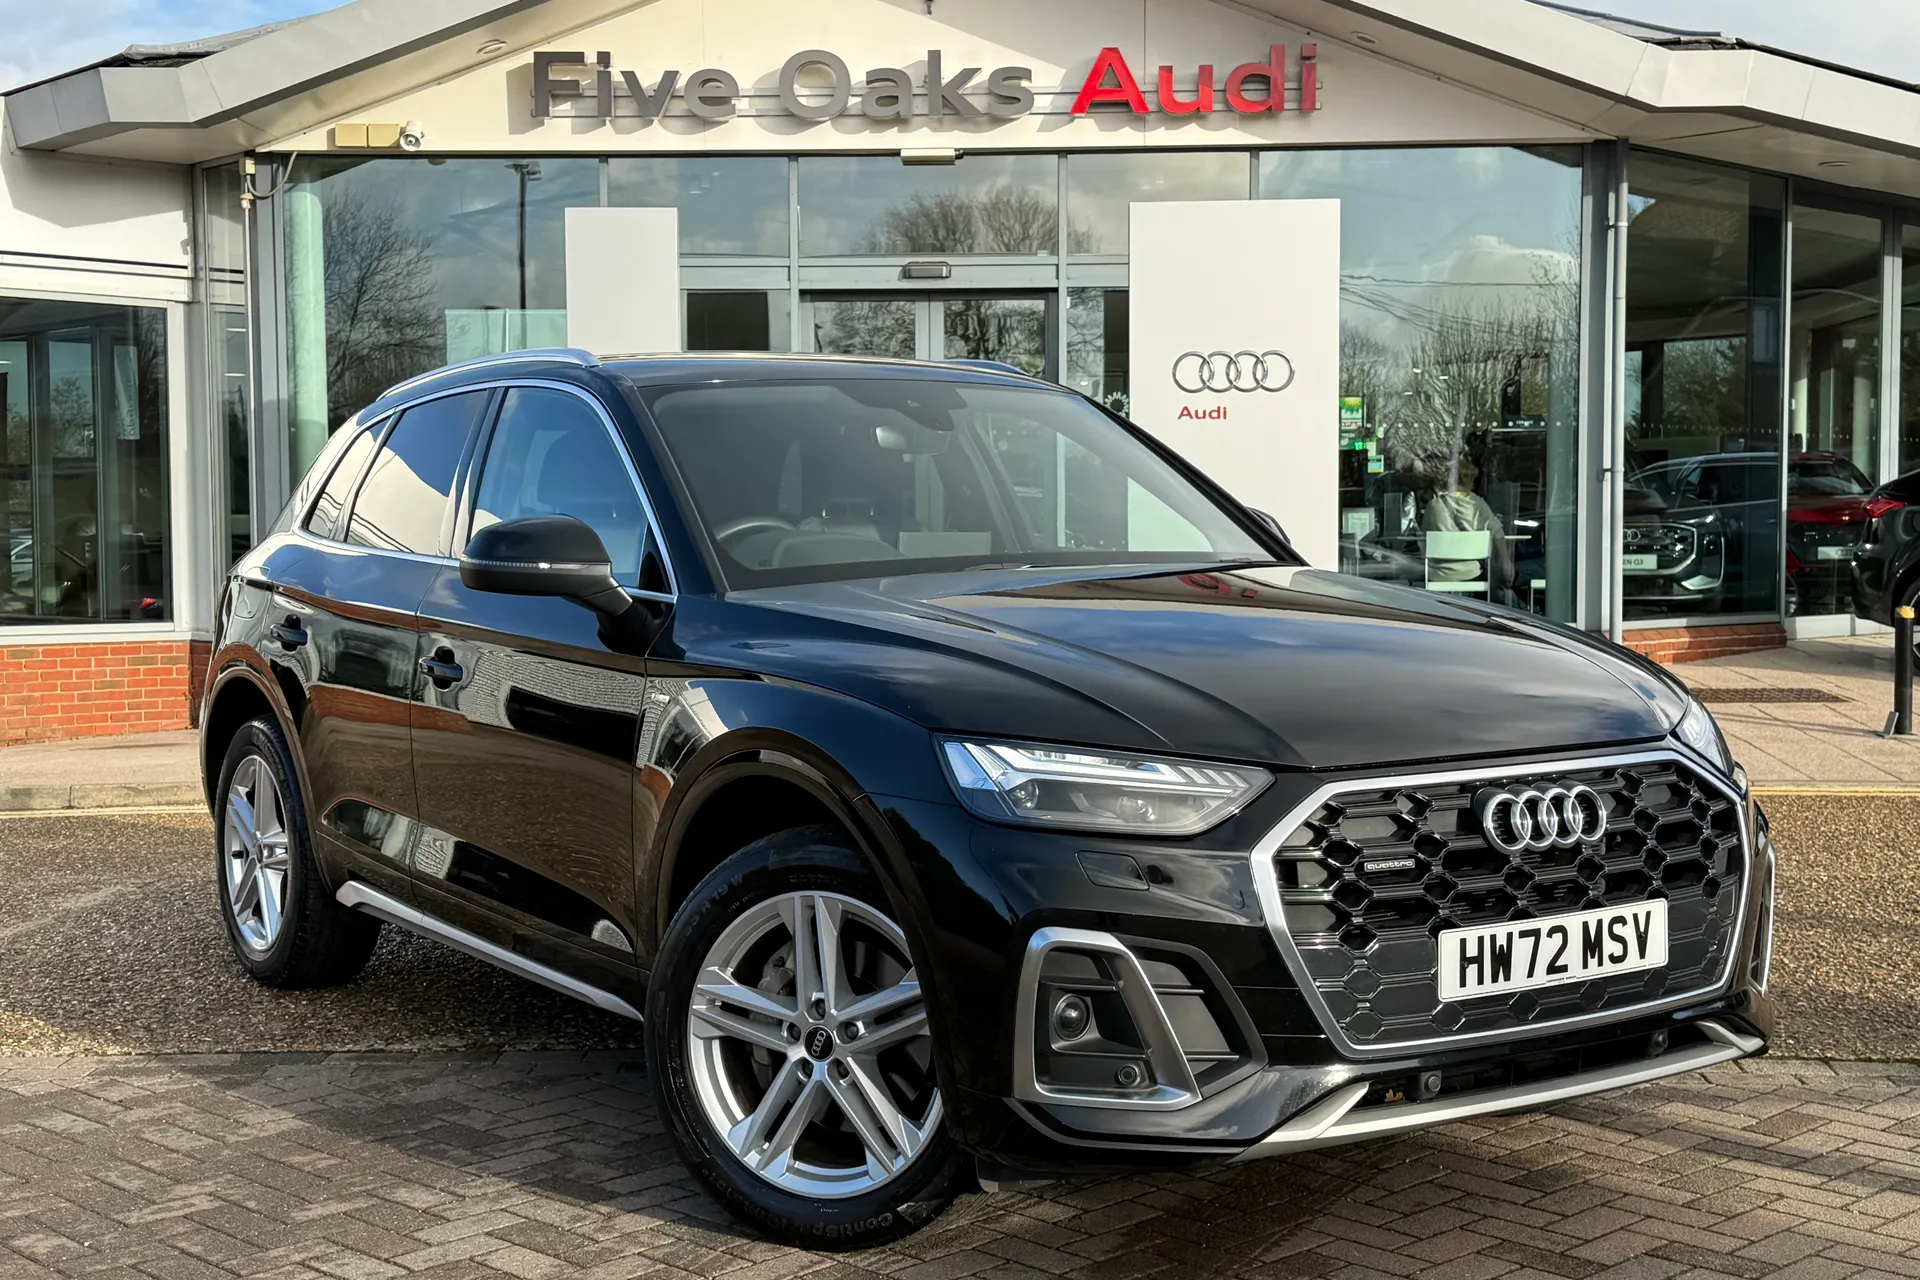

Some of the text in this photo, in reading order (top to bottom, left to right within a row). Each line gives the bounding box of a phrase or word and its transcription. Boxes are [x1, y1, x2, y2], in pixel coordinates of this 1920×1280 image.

[534, 43, 1317, 120] Five Oaks Audi
[1177, 405, 1227, 420] Audi
[1367, 861, 1413, 871] quattro
[1459, 910, 1652, 988] HW72 MSV
